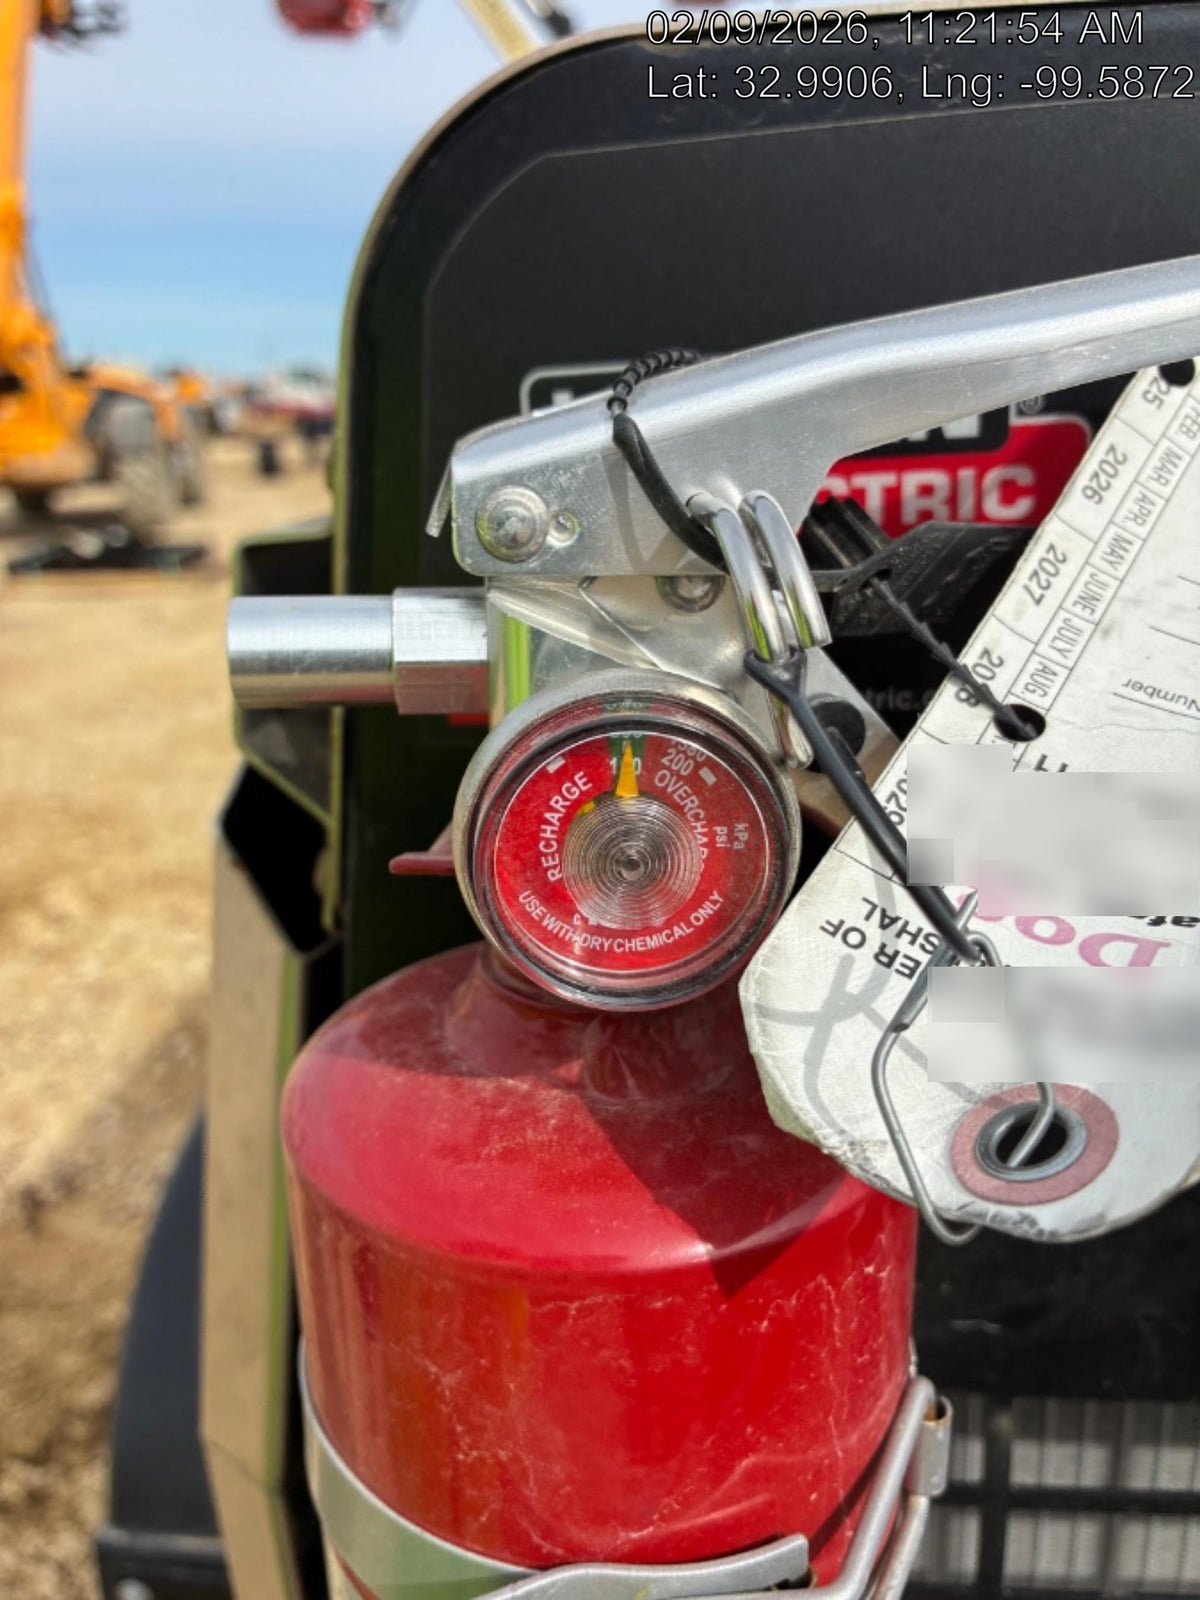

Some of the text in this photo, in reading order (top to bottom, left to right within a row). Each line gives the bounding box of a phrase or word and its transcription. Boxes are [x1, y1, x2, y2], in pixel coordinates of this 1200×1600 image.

[1081, 444, 1128, 505] 2026
[1023, 542, 1067, 606] 2027
[1100, 533, 1134, 572] MAY
[1072, 572, 1109, 616] JUNE
[1048, 617, 1085, 661] JULY
[955, 647, 1004, 707] 208
[1020, 661, 1058, 698] AUG.
[661, 748, 694, 777] 200
[538, 771, 592, 882] RECHARGE
[654, 768, 709, 868] OVERCHAR
[713, 825, 731, 848] psi
[733, 822, 749, 850] kPa
[518, 890, 545, 920] USE
[580, 934, 614, 951] DRY
[613, 922, 693, 953] CHEMICAL
[690, 890, 725, 926] ONLY
[819, 918, 867, 950] OF
